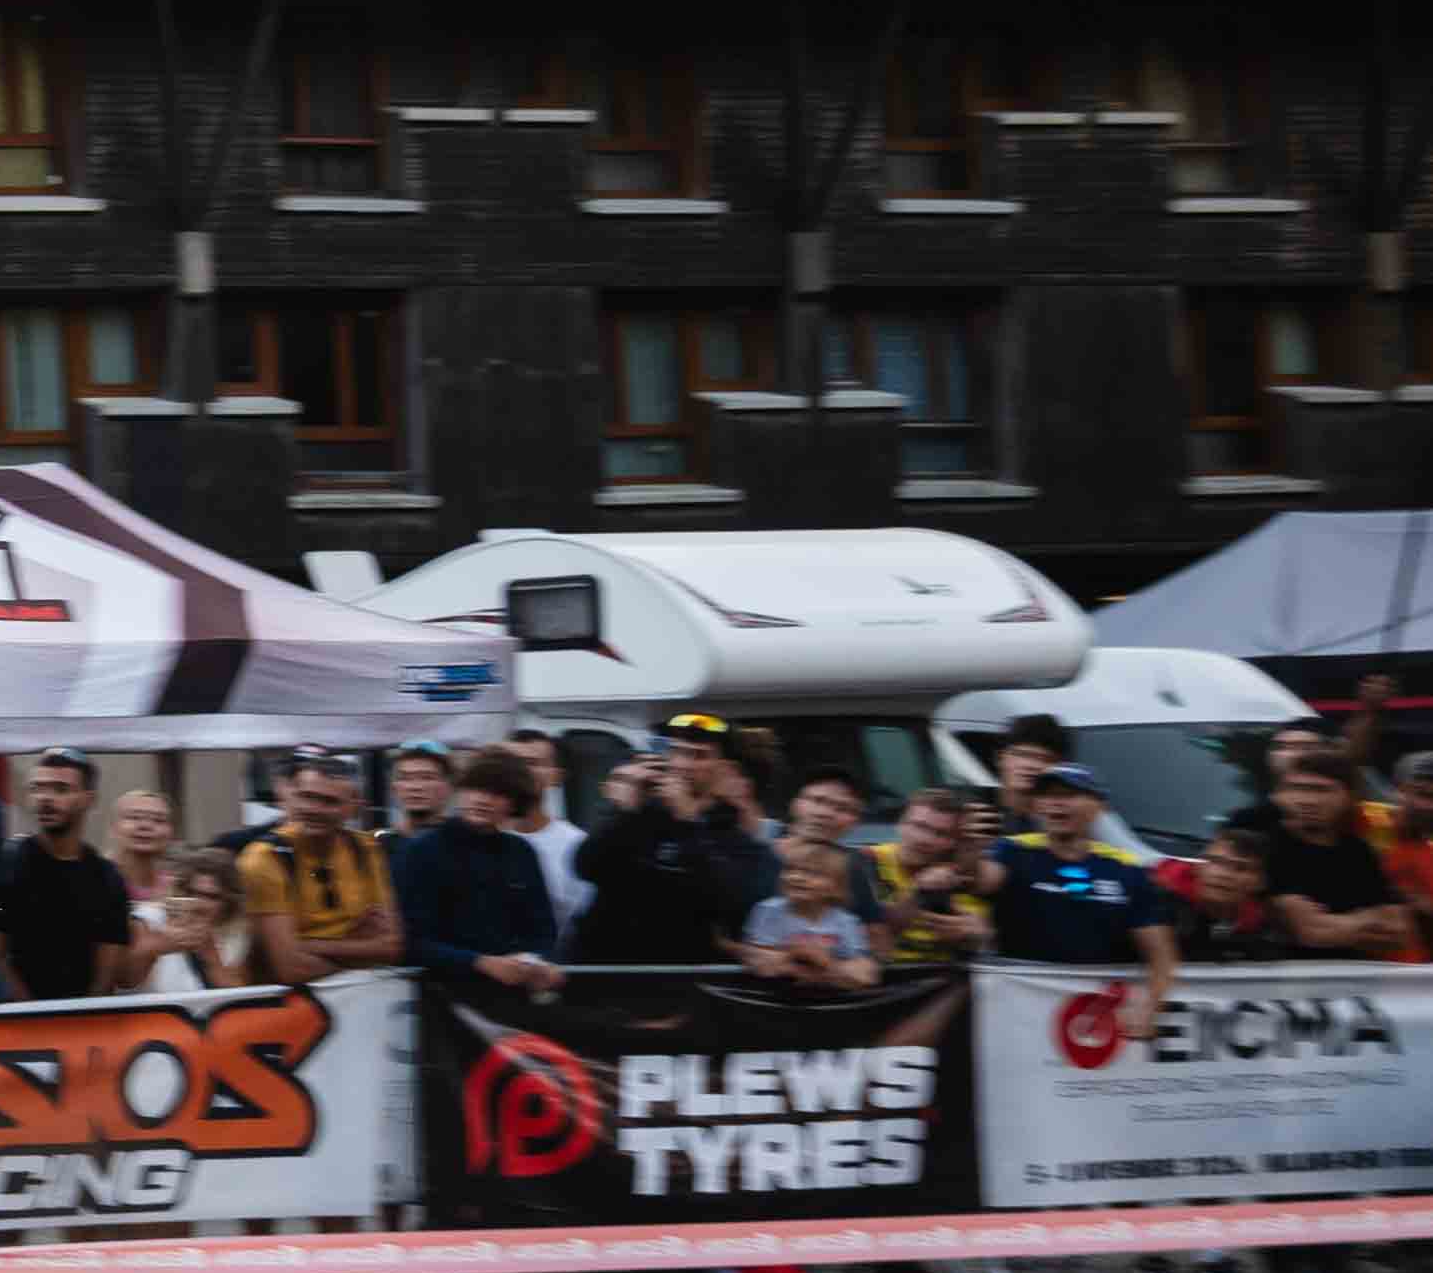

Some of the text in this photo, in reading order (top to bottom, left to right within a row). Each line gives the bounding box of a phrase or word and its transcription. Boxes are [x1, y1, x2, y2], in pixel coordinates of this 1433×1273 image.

[1150, 996, 1402, 1062] EICMA
[618, 1046, 937, 1117] PLEWS
[617, 1118, 927, 1195] TYRES
